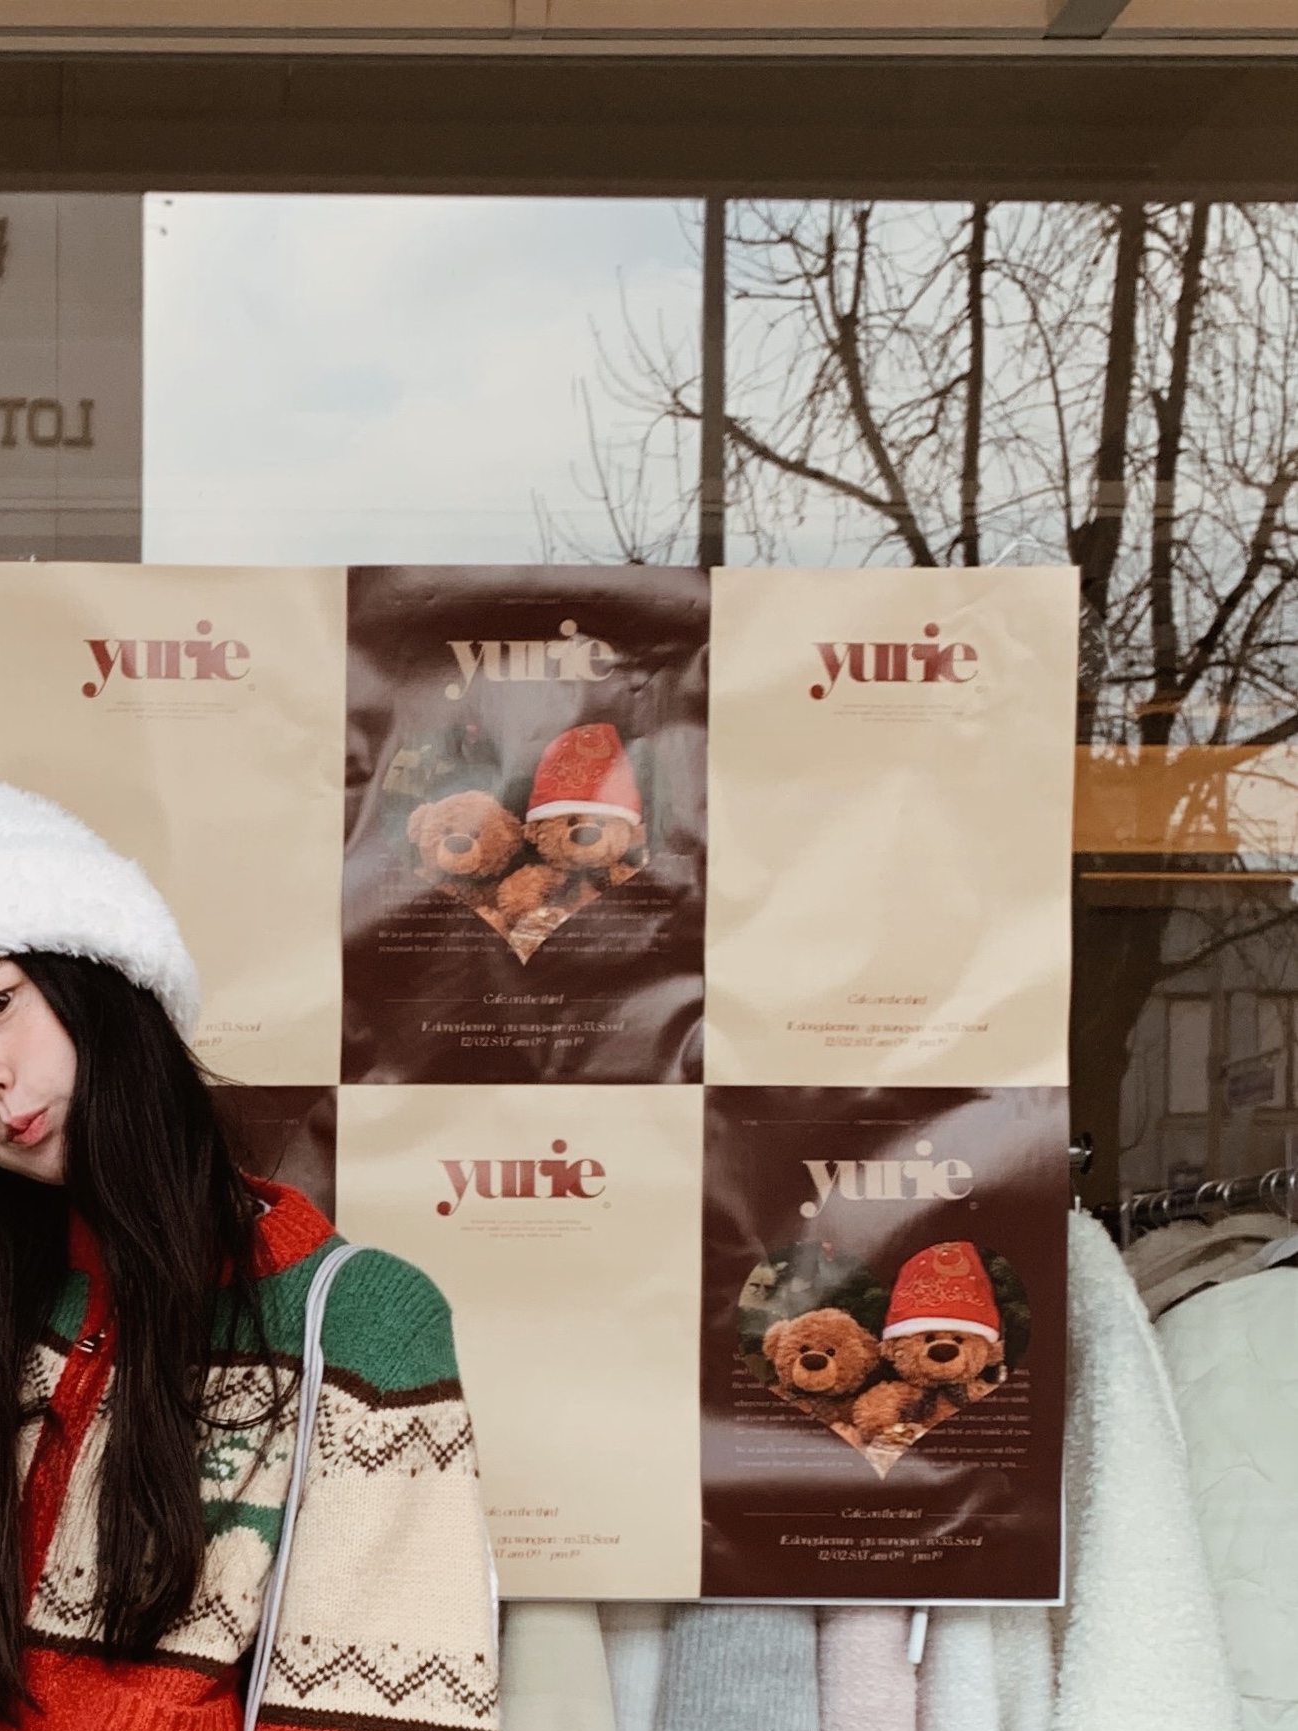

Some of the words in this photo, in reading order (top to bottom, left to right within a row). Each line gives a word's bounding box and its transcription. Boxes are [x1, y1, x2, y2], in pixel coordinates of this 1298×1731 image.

[82, 619, 251, 699] yurie
[444, 619, 616, 701] yurie
[809, 622, 979, 700] yurie
[436, 1139, 606, 1216] yurie
[799, 1140, 973, 1218] yurie
